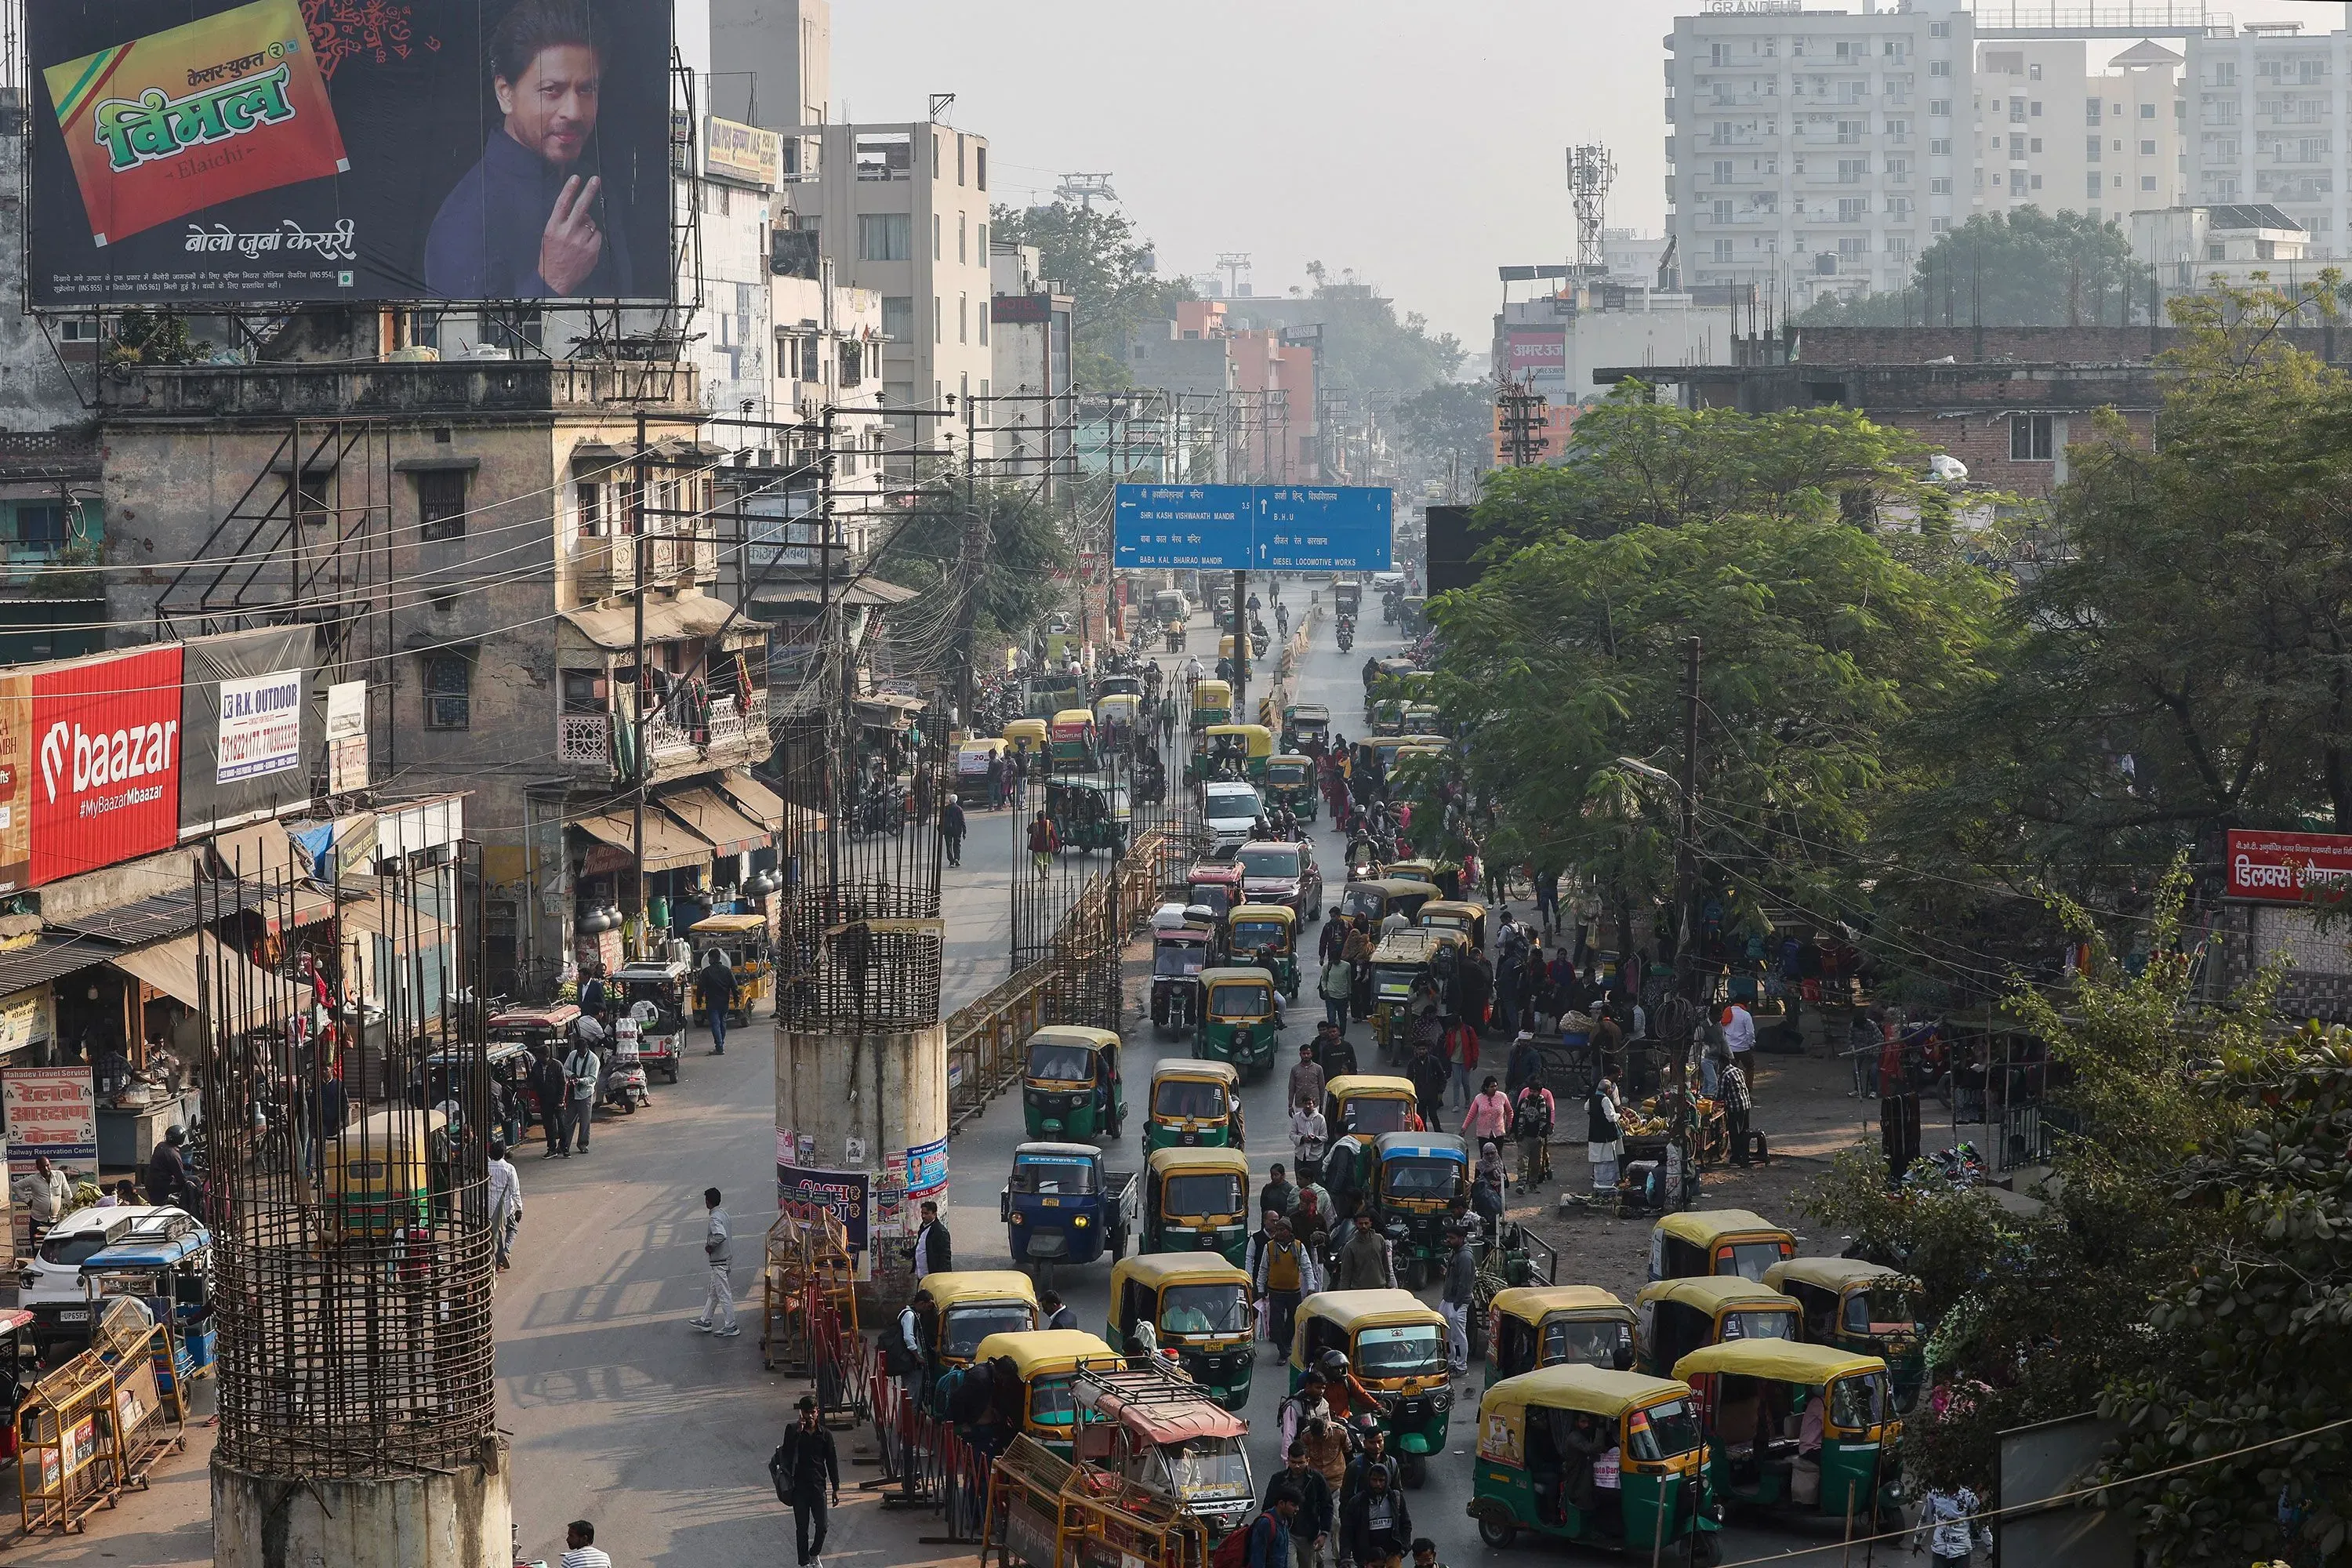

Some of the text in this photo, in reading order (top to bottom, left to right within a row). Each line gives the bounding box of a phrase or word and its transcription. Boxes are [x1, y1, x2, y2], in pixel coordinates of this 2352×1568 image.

[95, 62, 296, 173] विमल
[176, 144, 244, 181] Elaichi
[184, 224, 236, 252] बोलो
[283, 219, 358, 261] केसरी
[997, 298, 1039, 309] HOTEL
[1274, 492, 1287, 501] काशी
[1241, 502, 1250, 510] 3.5
[1156, 511, 1174, 520] KASHI
[1175, 512, 1212, 521] VISHWANATH
[1214, 512, 1235, 521] MANDIR
[1173, 556, 1200, 564] BHAIRAO
[1201, 557, 1223, 565] MANDIR
[1273, 557, 1356, 567] DIESEL LOCOMOTIVE WORKS
[235, 683, 297, 717] R.K. OUTDOOR
[80, 784, 163, 819] #MyBaazarMbaazar
[2234, 855, 2291, 887] डिलक्स
[3, 1070, 37, 1079] Mahadev
[10, 1080, 85, 1102] रेलवे
[10, 1105, 91, 1123] आरक्षण
